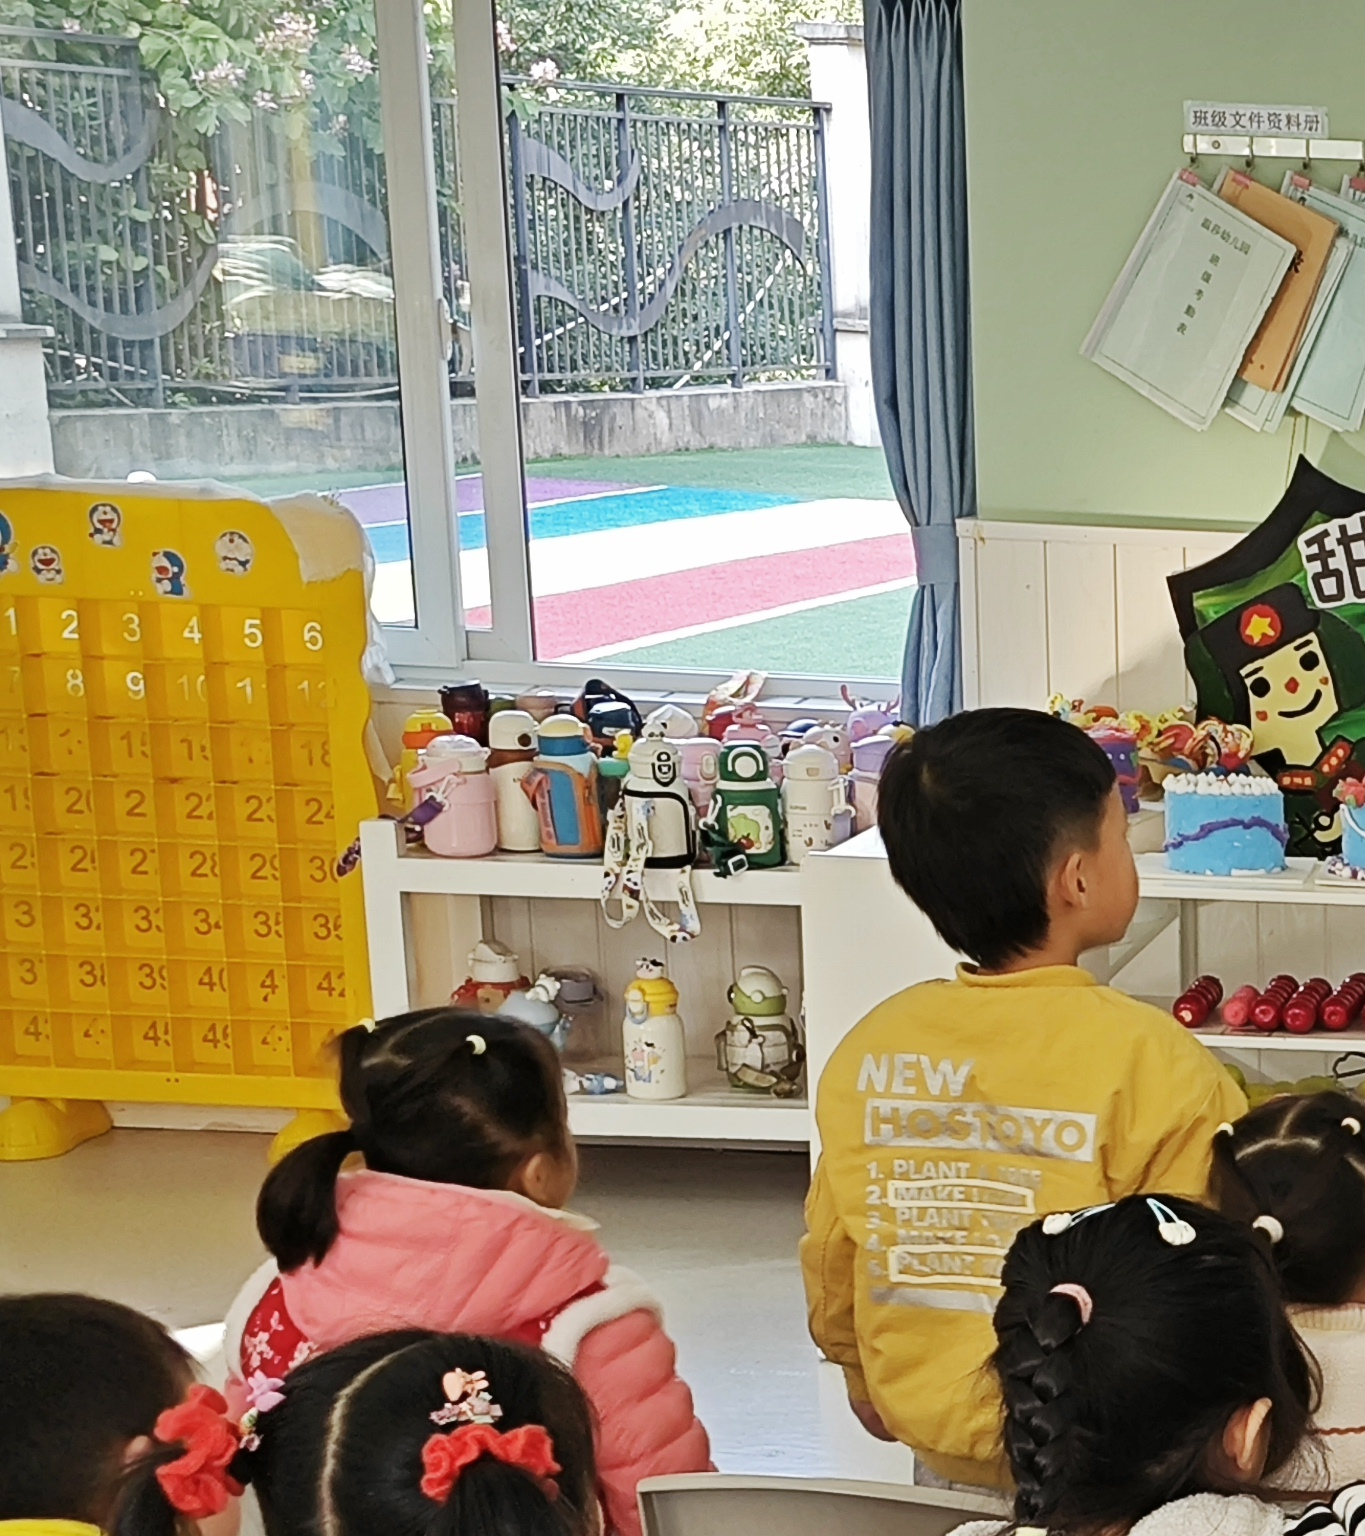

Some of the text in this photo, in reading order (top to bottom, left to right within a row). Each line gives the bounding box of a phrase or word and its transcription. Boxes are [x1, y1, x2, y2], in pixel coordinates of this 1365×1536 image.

[1191, 109, 1321, 132] 班级文件资料册
[3, 607, 323, 651] 1 2 3 4 5 6
[66, 669, 85, 697] 8
[125, 671, 145, 700] 9
[9, 842, 37, 870] 2
[19, 958, 44, 985] 3
[23, 1015, 50, 1043] 4
[856, 1053, 976, 1097] NEW
[892, 1159, 971, 1180] PLANT
[897, 1185, 966, 1202] MAKE
[895, 1207, 974, 1229] PLANT
